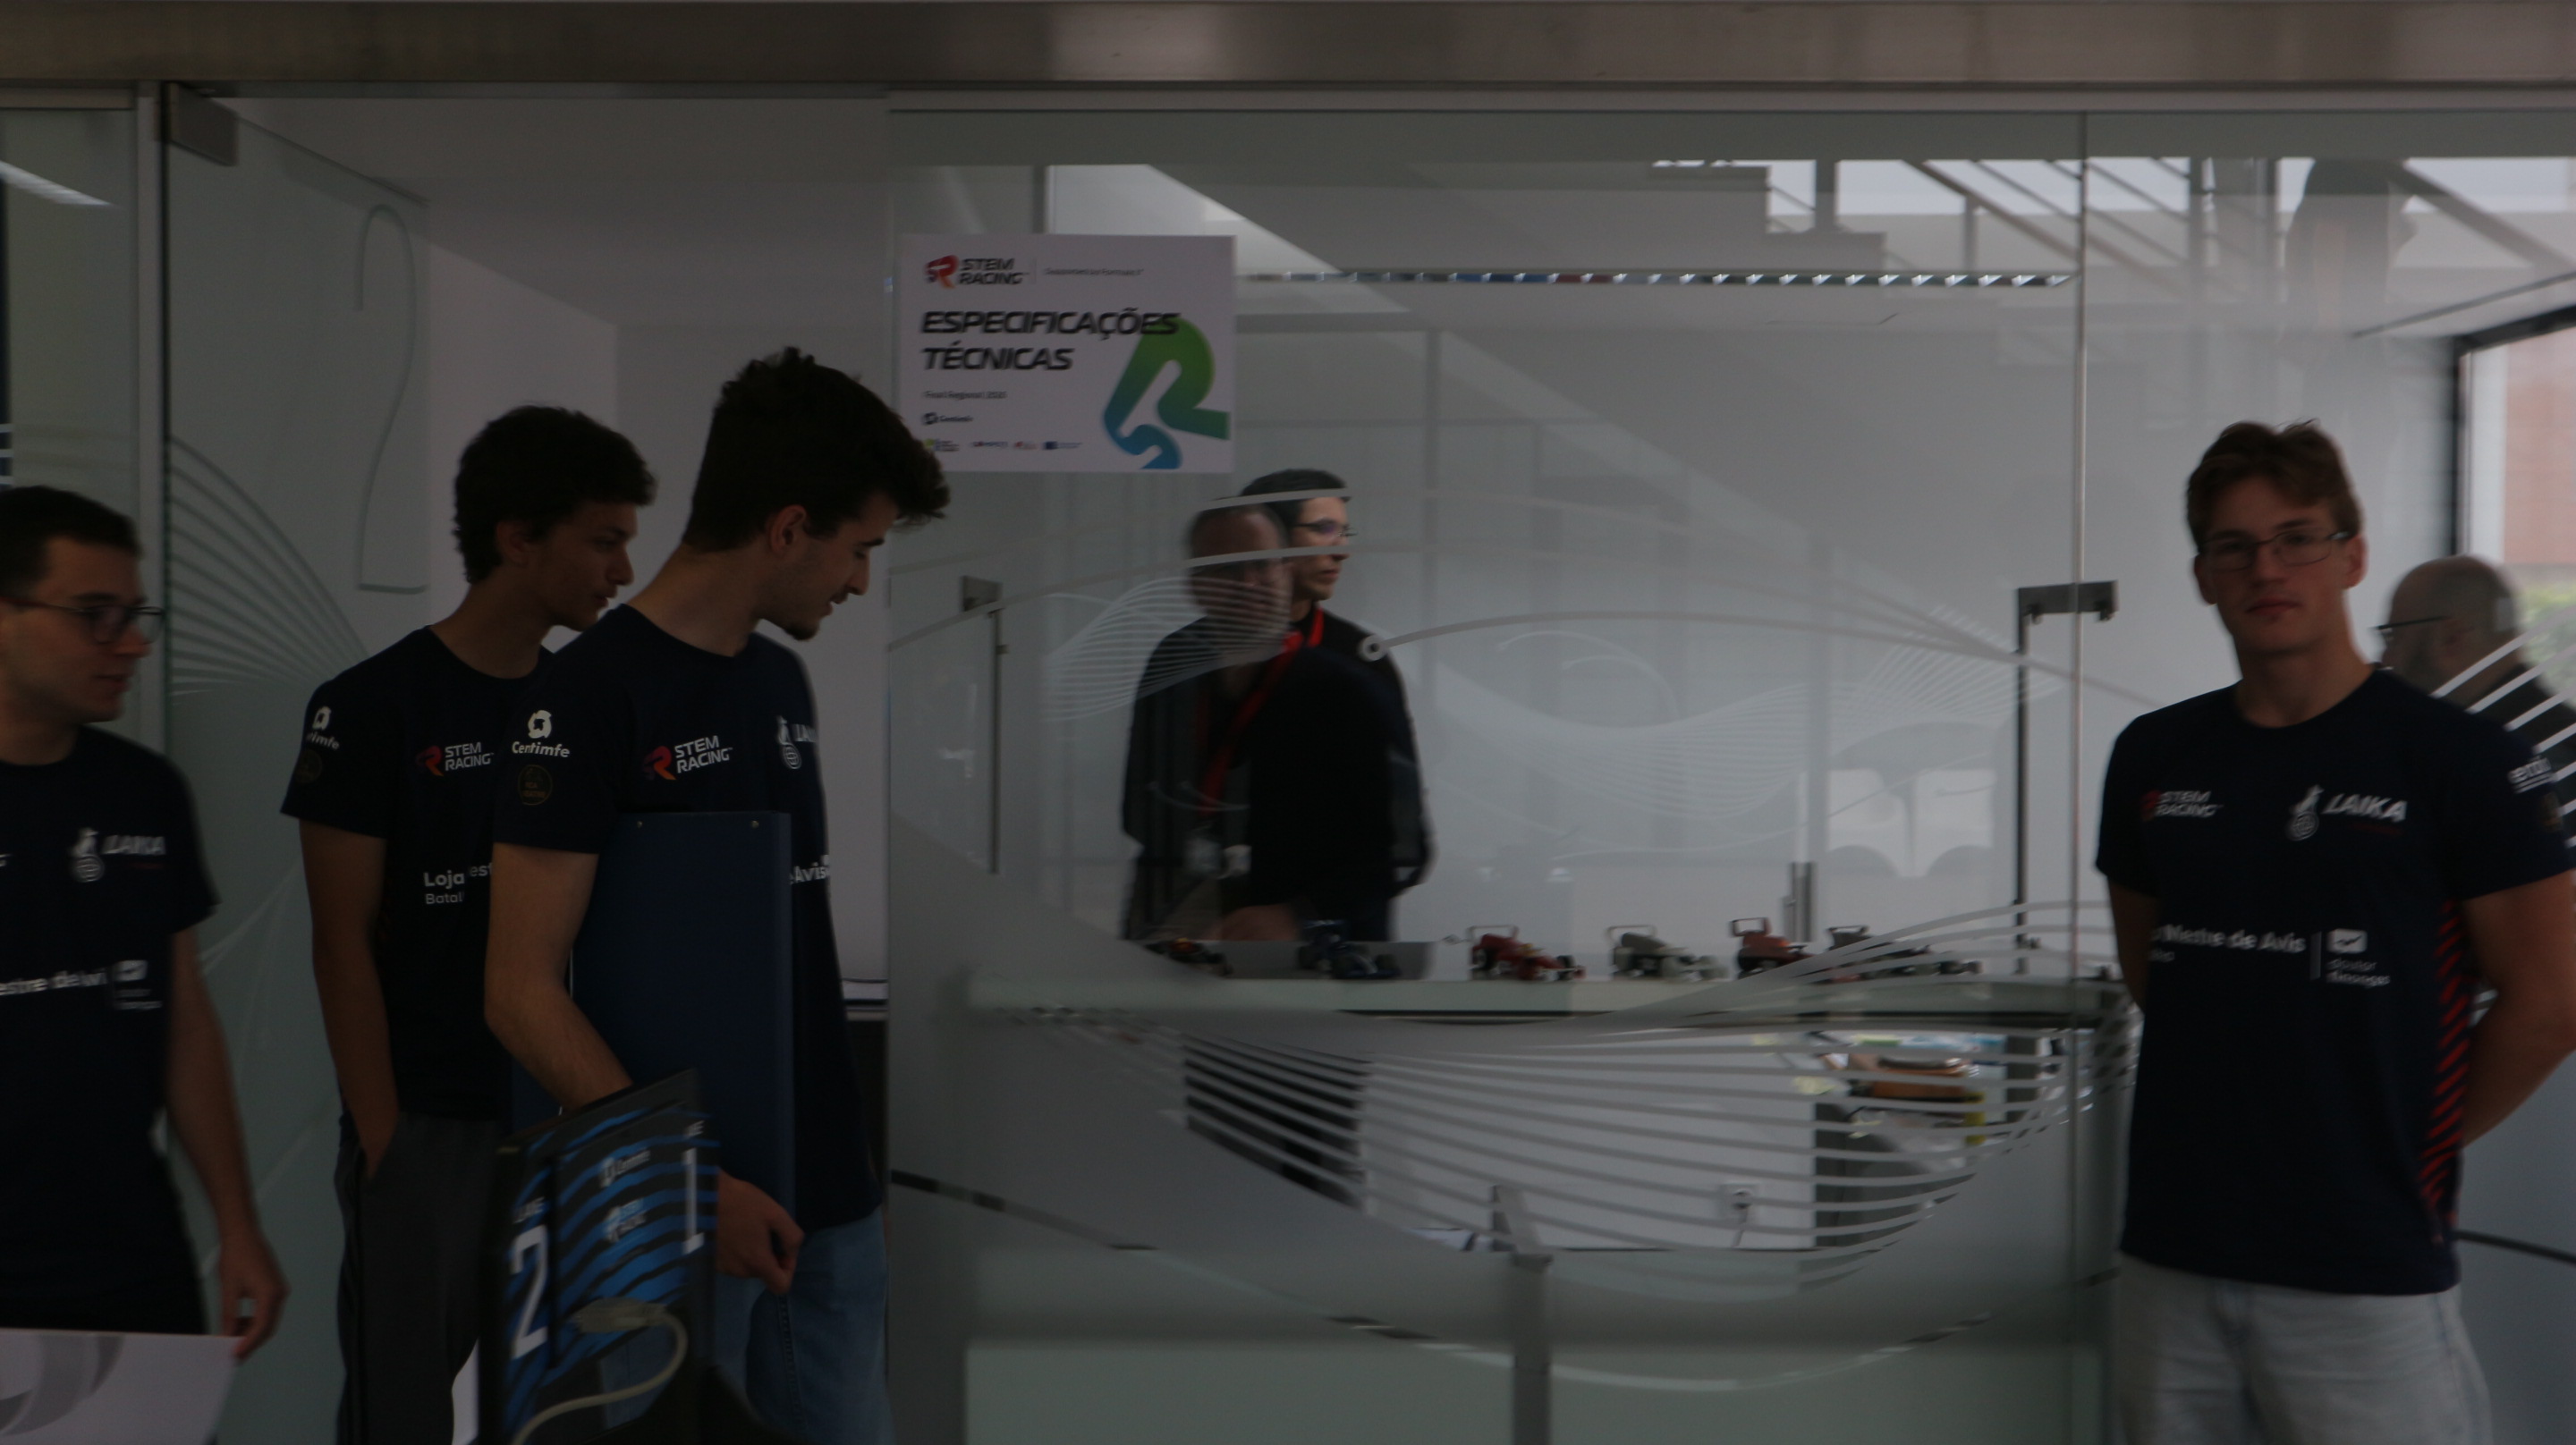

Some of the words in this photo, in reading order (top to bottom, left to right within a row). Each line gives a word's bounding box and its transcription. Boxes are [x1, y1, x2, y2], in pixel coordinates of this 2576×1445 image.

[960, 258, 1015, 270] STEM
[959, 272, 1023, 285] RACING
[921, 308, 1181, 341] ESPECIFICAÇÕES
[922, 341, 1074, 370] TÉCNICAS
[445, 741, 483, 759] STEM
[511, 739, 572, 759] Centimfe
[674, 734, 721, 758] STEM
[445, 753, 492, 772] RACING
[676, 748, 732, 774] RACING
[2156, 790, 2212, 804] STEM
[2320, 792, 2408, 823] LAIKA
[2154, 803, 2218, 818] RACING
[423, 868, 466, 890] Loja
[509, 1223, 549, 1361] 2
